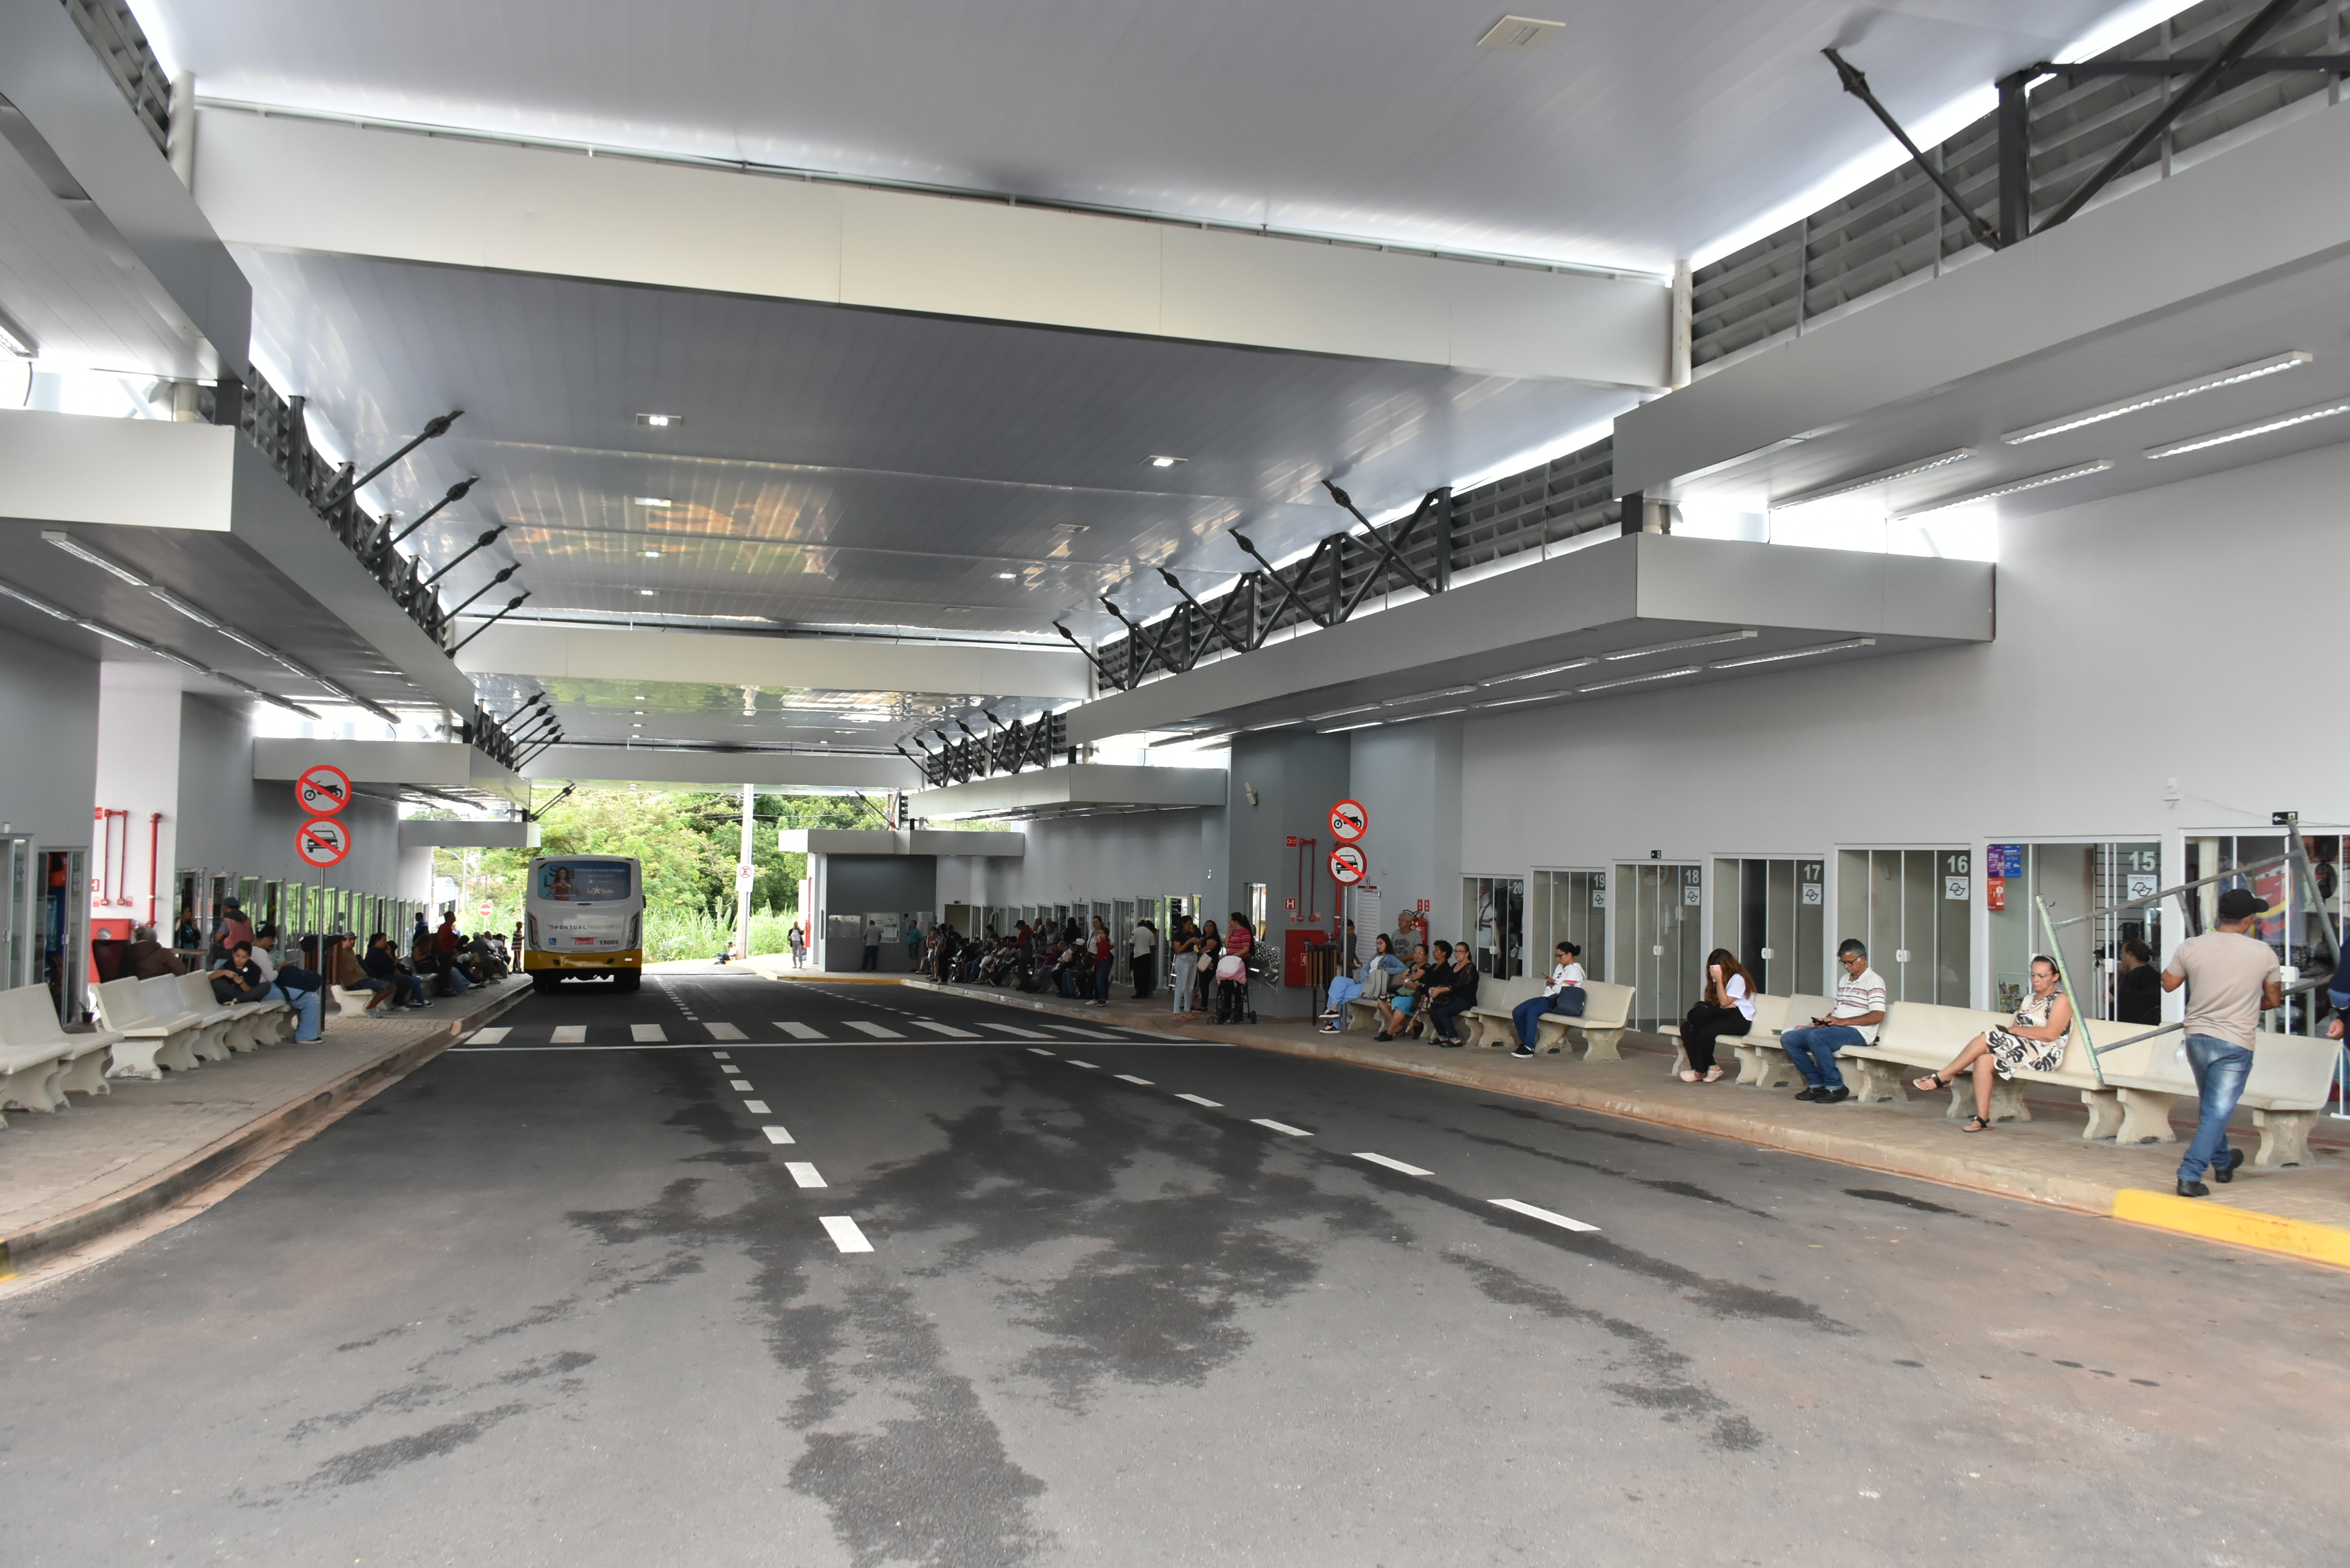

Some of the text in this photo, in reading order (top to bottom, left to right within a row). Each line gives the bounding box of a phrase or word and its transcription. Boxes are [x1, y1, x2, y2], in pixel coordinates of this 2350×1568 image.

[1948, 855, 1968, 873] 16
[2128, 851, 2155, 871] 15
[1686, 869, 1699, 884] 18
[1804, 864, 1821, 880] 17
[1513, 882, 1523, 894] 20
[1594, 874, 1605, 887] 19
[1286, 899, 1294, 908] H
